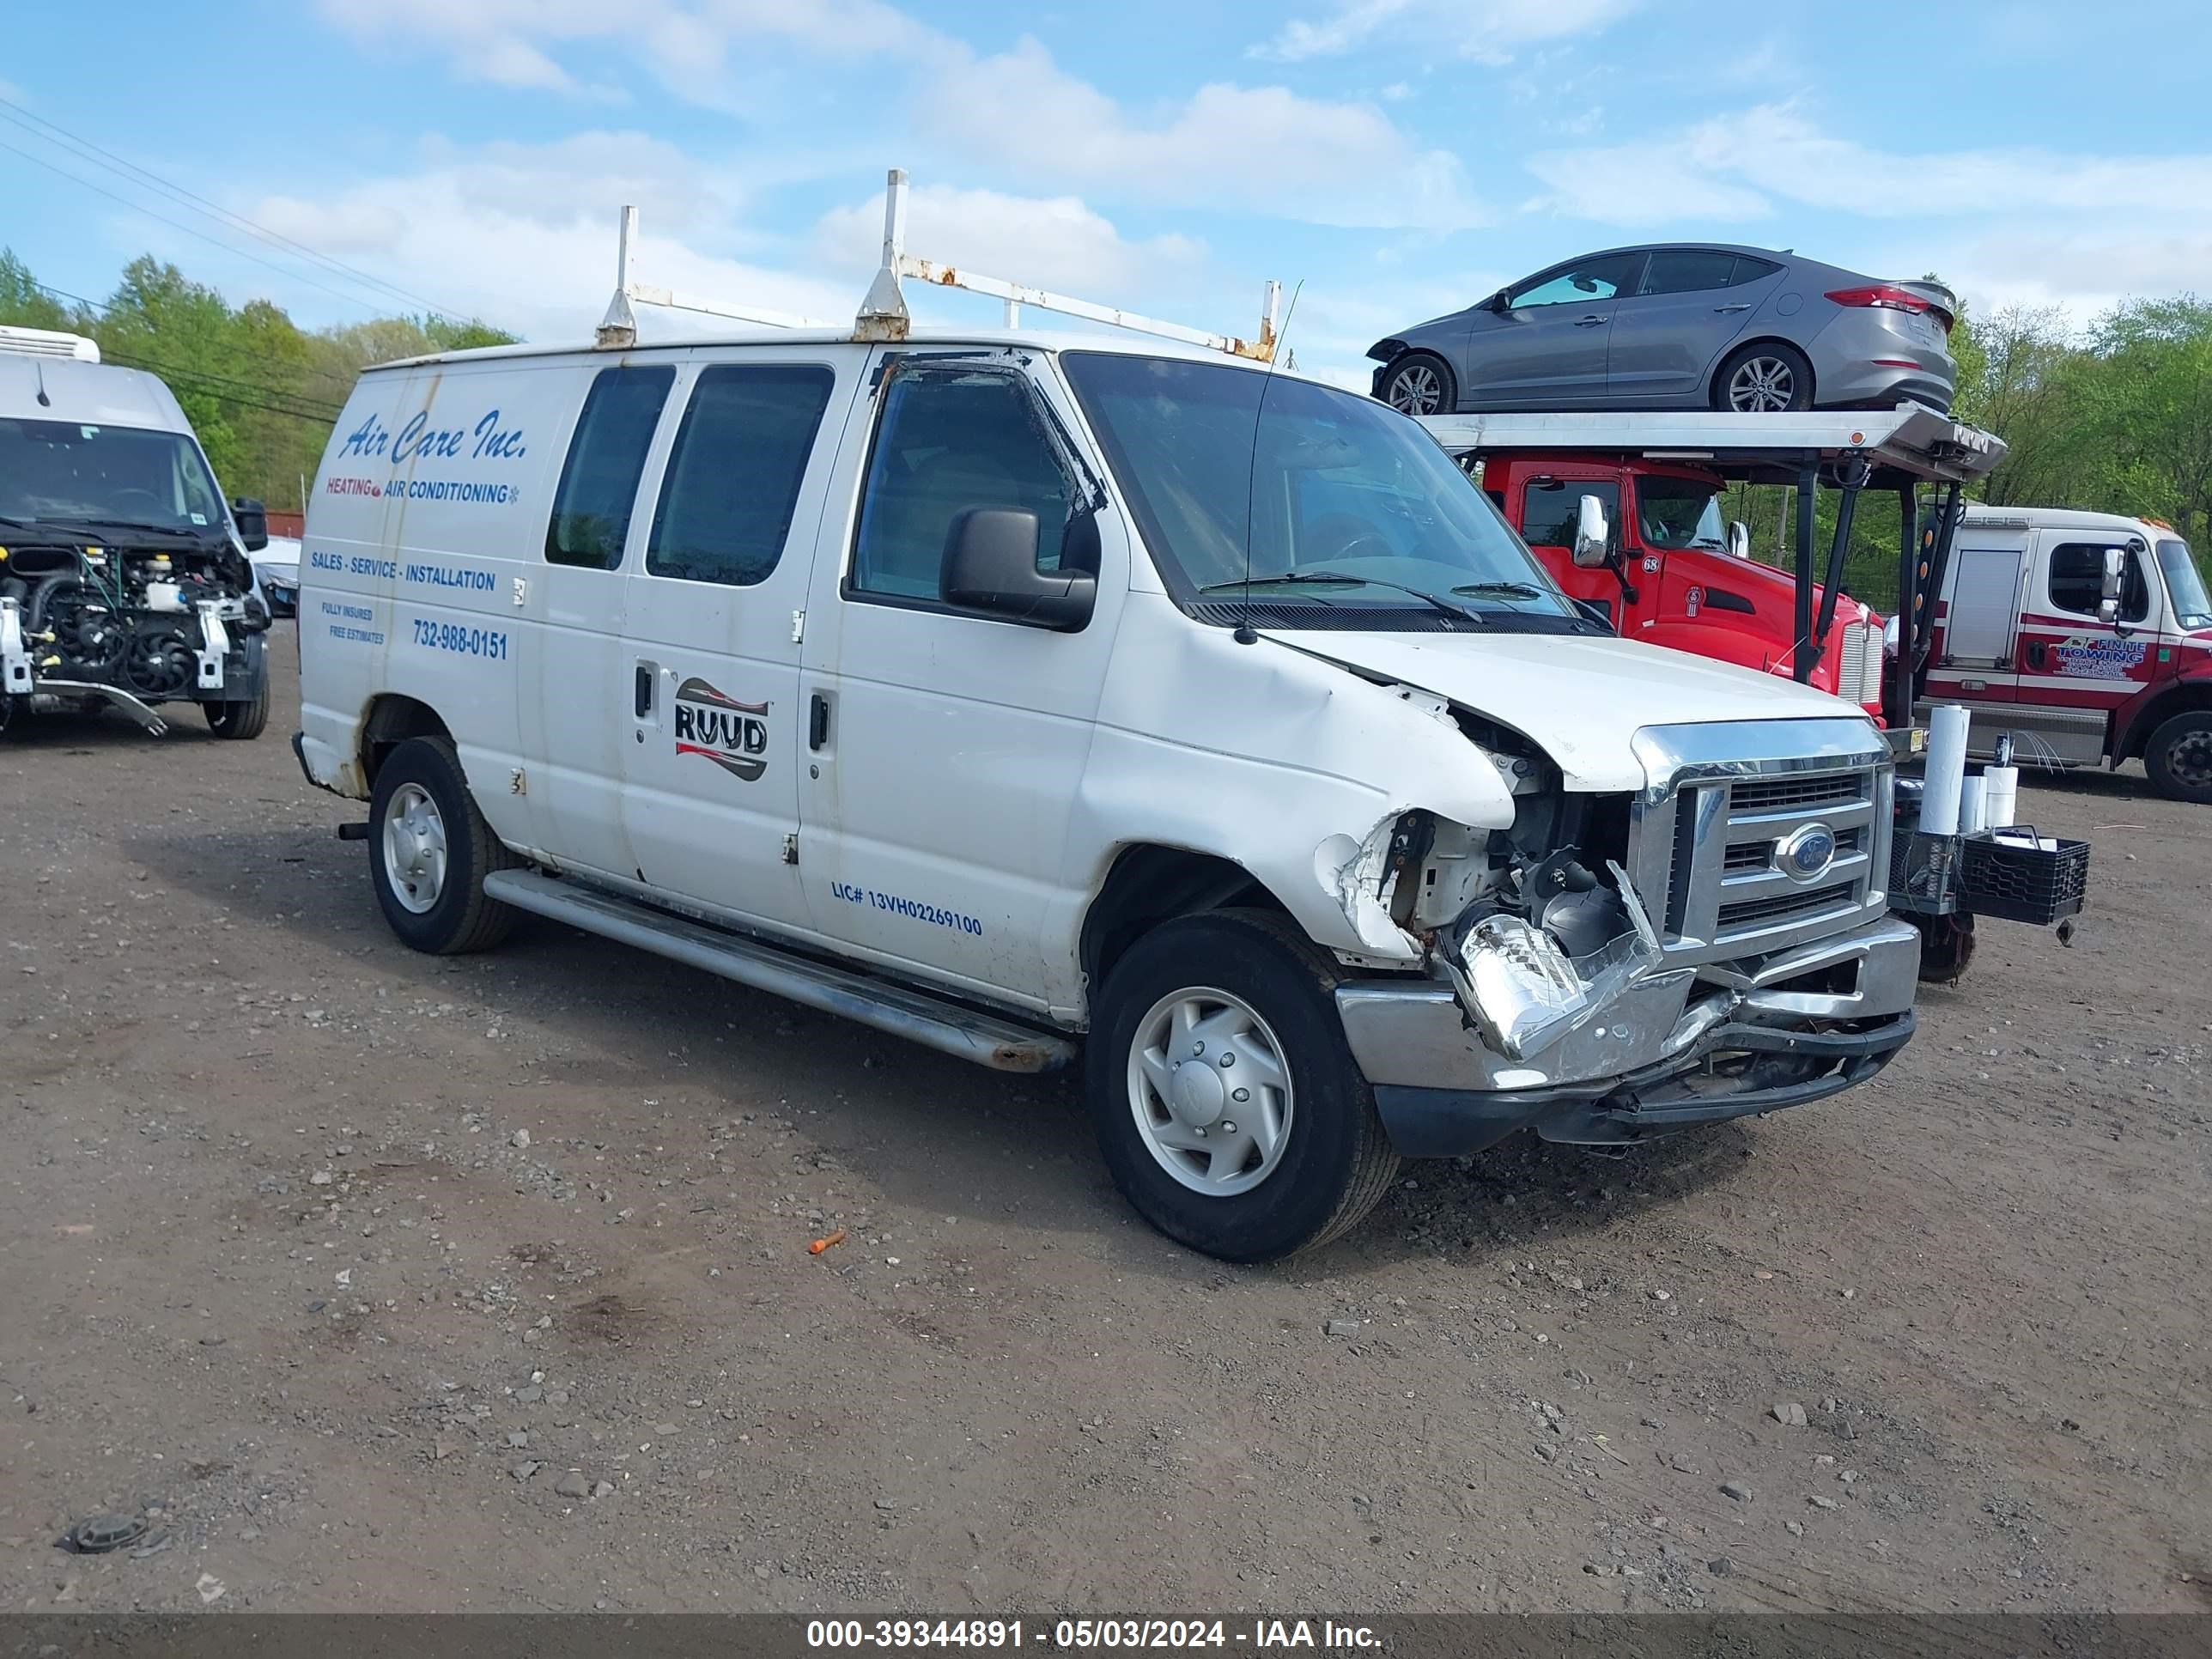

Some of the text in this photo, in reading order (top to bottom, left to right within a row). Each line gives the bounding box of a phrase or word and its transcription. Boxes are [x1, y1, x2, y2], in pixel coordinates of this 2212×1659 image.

[338, 410, 526, 464] Air Care Inc.
[326, 477, 508, 504] HEATING AIR CONDITIONING
[312, 552, 343, 571] SALES
[350, 556, 396, 579] SERVICE
[405, 564, 495, 592] INSTALLATION
[1644, 559, 1657, 571] 68
[322, 602, 342, 615] FULLY
[330, 625, 385, 645] FREE ESTIMATES
[414, 619, 507, 660] 732-988-0151
[2057, 646, 2144, 664] TOWING
[677, 705, 767, 754] RUUD
[831, 882, 983, 936] LIC# 13VH02269100
